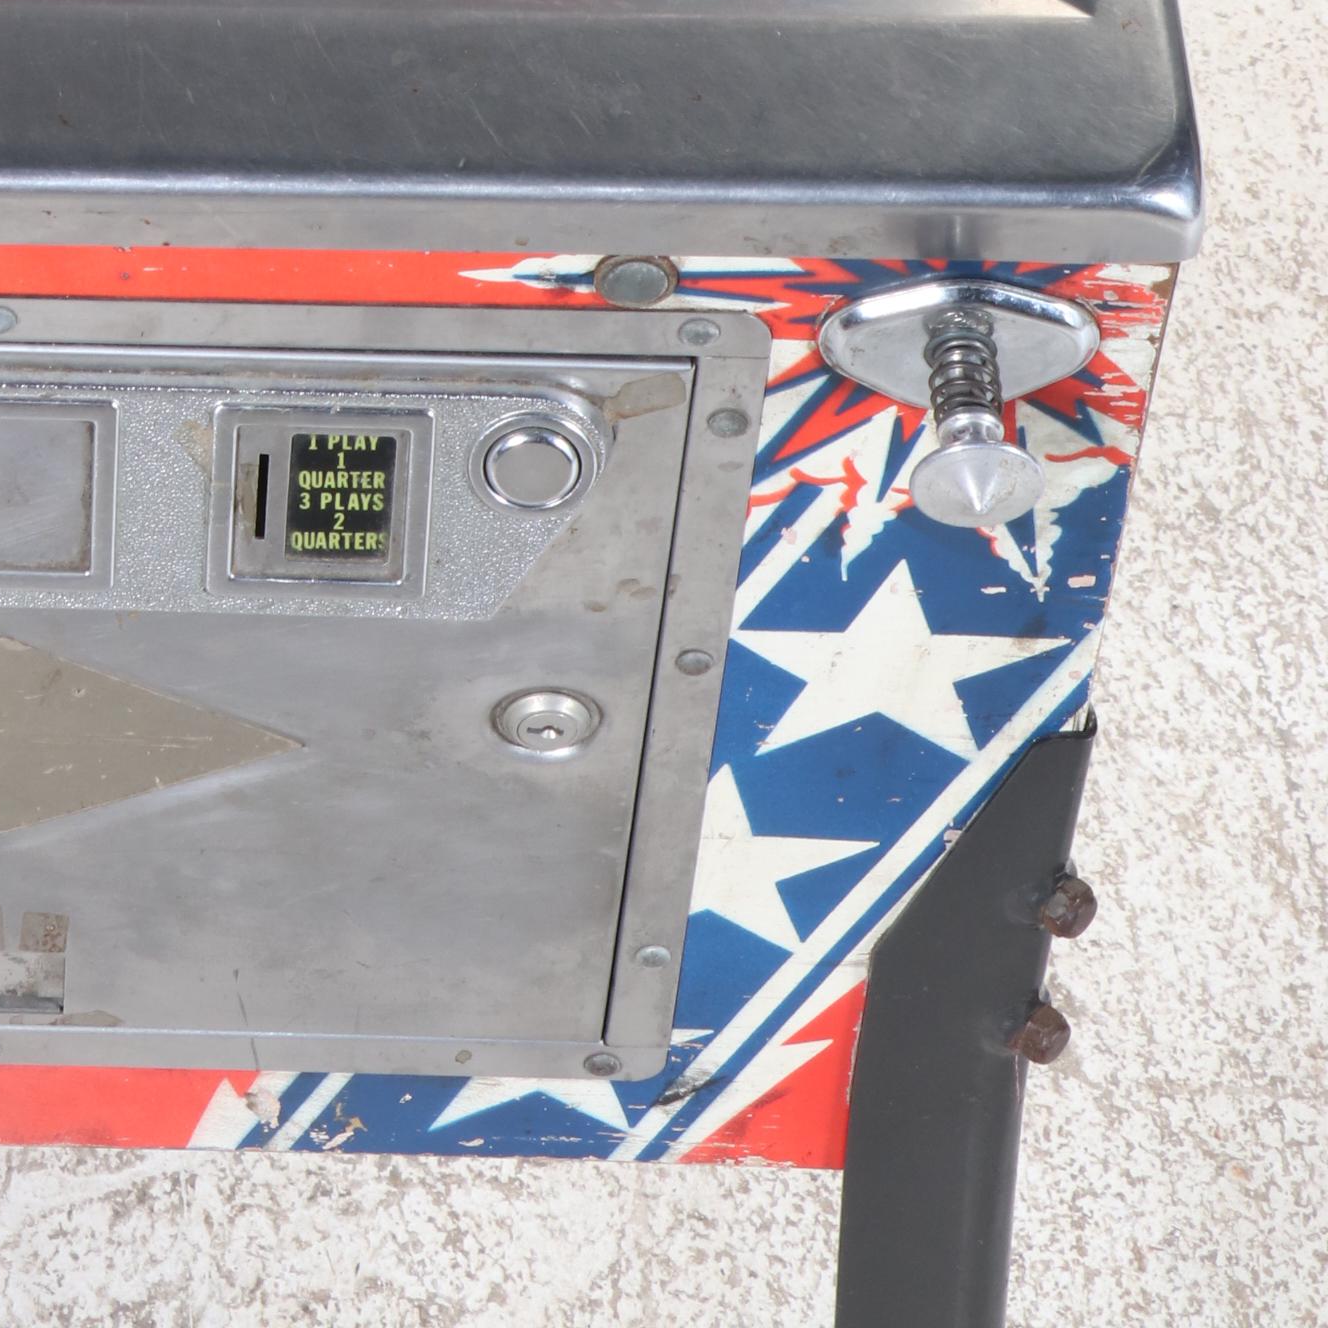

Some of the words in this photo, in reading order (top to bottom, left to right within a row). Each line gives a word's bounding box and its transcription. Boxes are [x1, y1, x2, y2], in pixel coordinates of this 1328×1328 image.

[308, 434, 318, 450] 1
[328, 434, 379, 451] PLAY
[337, 452, 346, 469] 1
[298, 470, 385, 490] QUARTER
[299, 492, 311, 510] 3
[320, 493, 384, 511] PLAYS
[333, 512, 345, 530] 2
